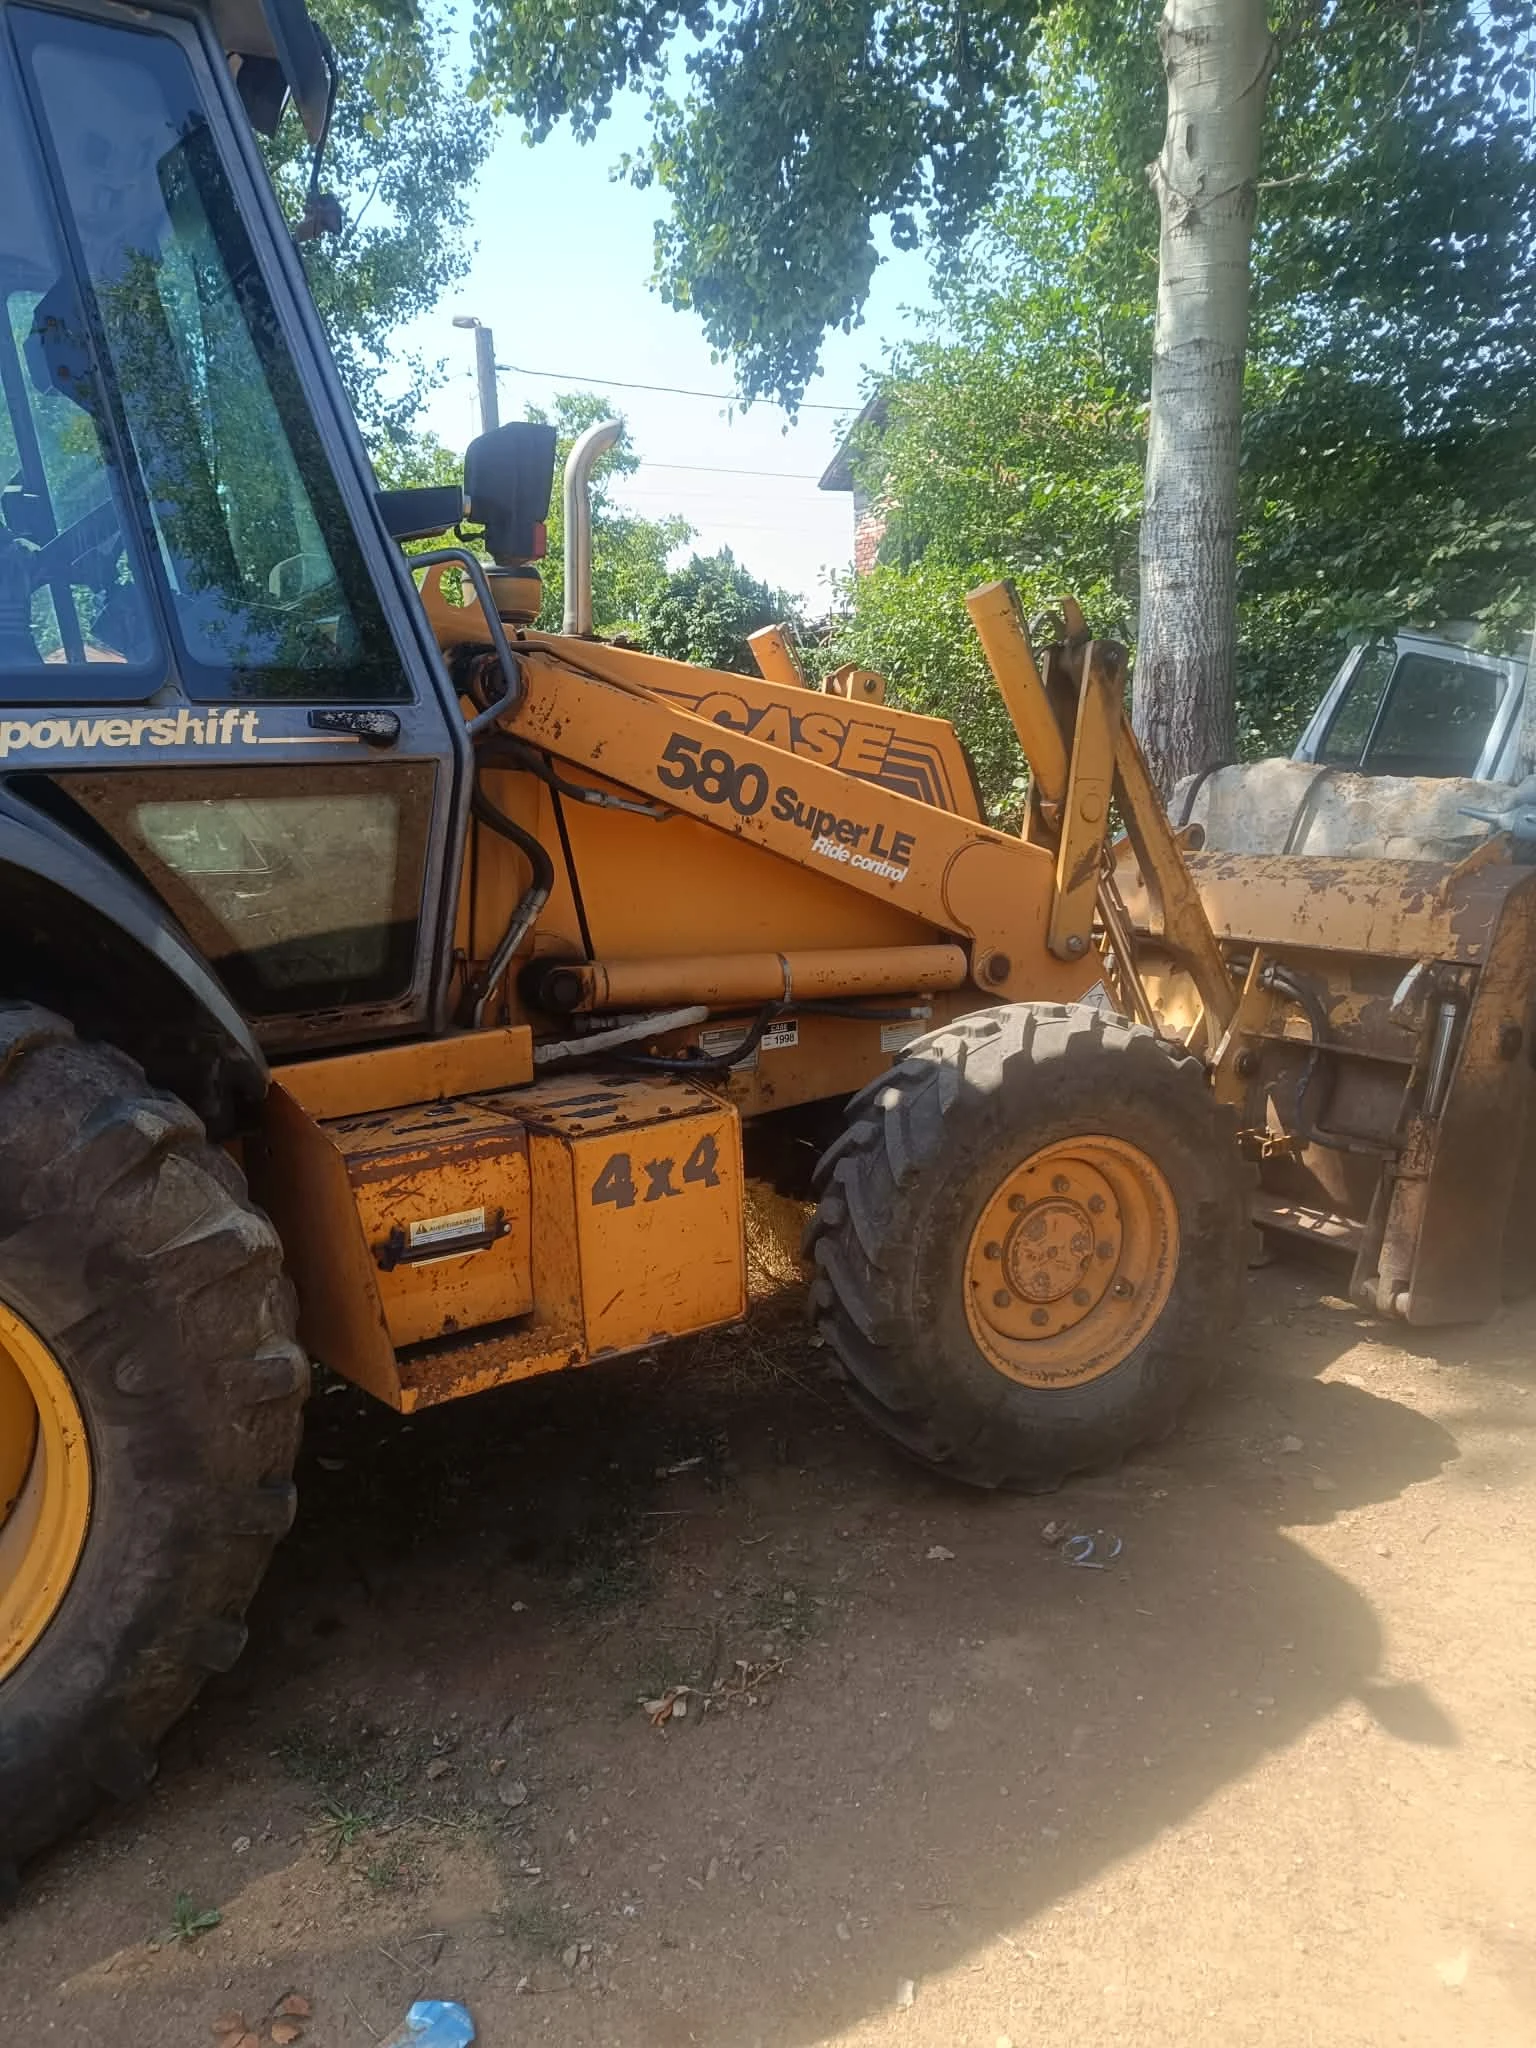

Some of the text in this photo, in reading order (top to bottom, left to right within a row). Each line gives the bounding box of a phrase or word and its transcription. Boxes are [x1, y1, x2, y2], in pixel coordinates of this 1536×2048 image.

[0, 708, 259, 758] powershift
[695, 691, 896, 775] CASE
[656, 732, 917, 867] 580 Super LE
[811, 836, 909, 883] Ride control
[591, 1134, 721, 1210] 4x4
